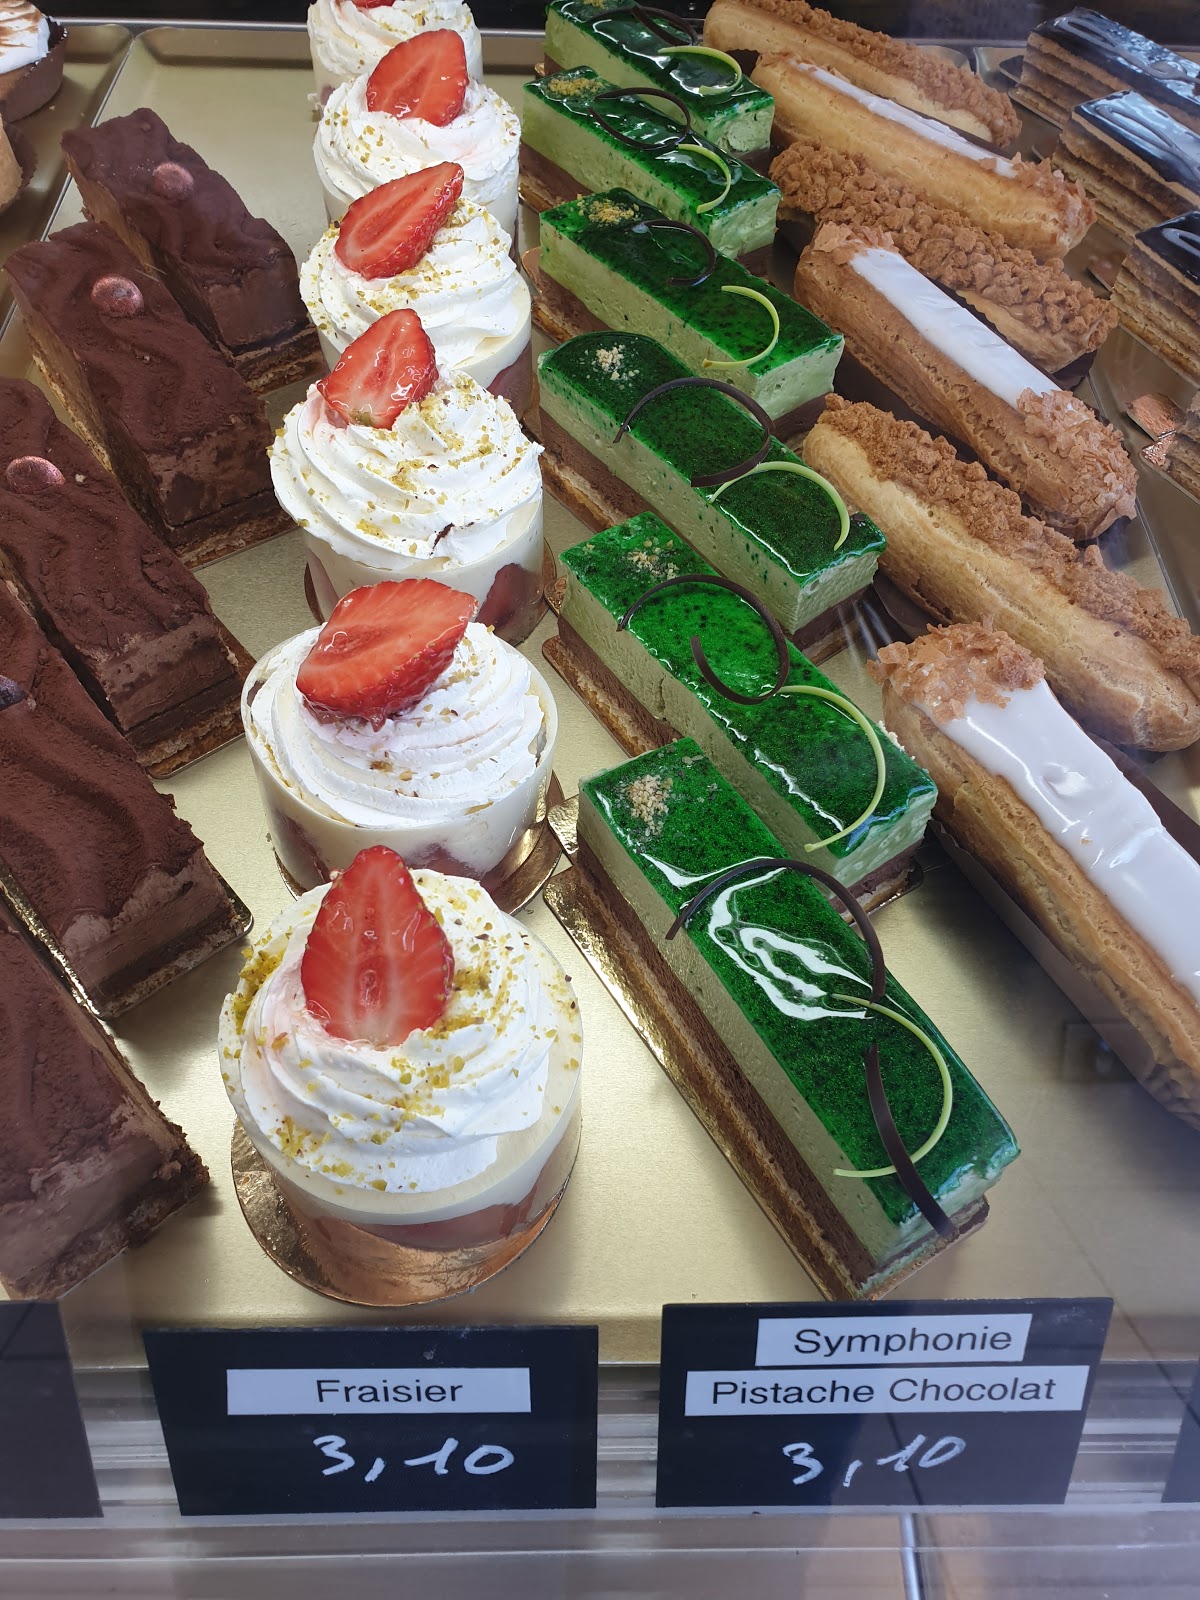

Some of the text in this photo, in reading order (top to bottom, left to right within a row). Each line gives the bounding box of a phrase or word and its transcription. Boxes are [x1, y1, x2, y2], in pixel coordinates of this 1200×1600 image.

[794, 1324, 1012, 1358] Symphonie
[316, 1378, 464, 1403] Fraisier
[712, 1377, 1057, 1405] Pistache Chocolat
[313, 1434, 515, 1483] 3,10
[782, 1434, 967, 1487] 3,10
